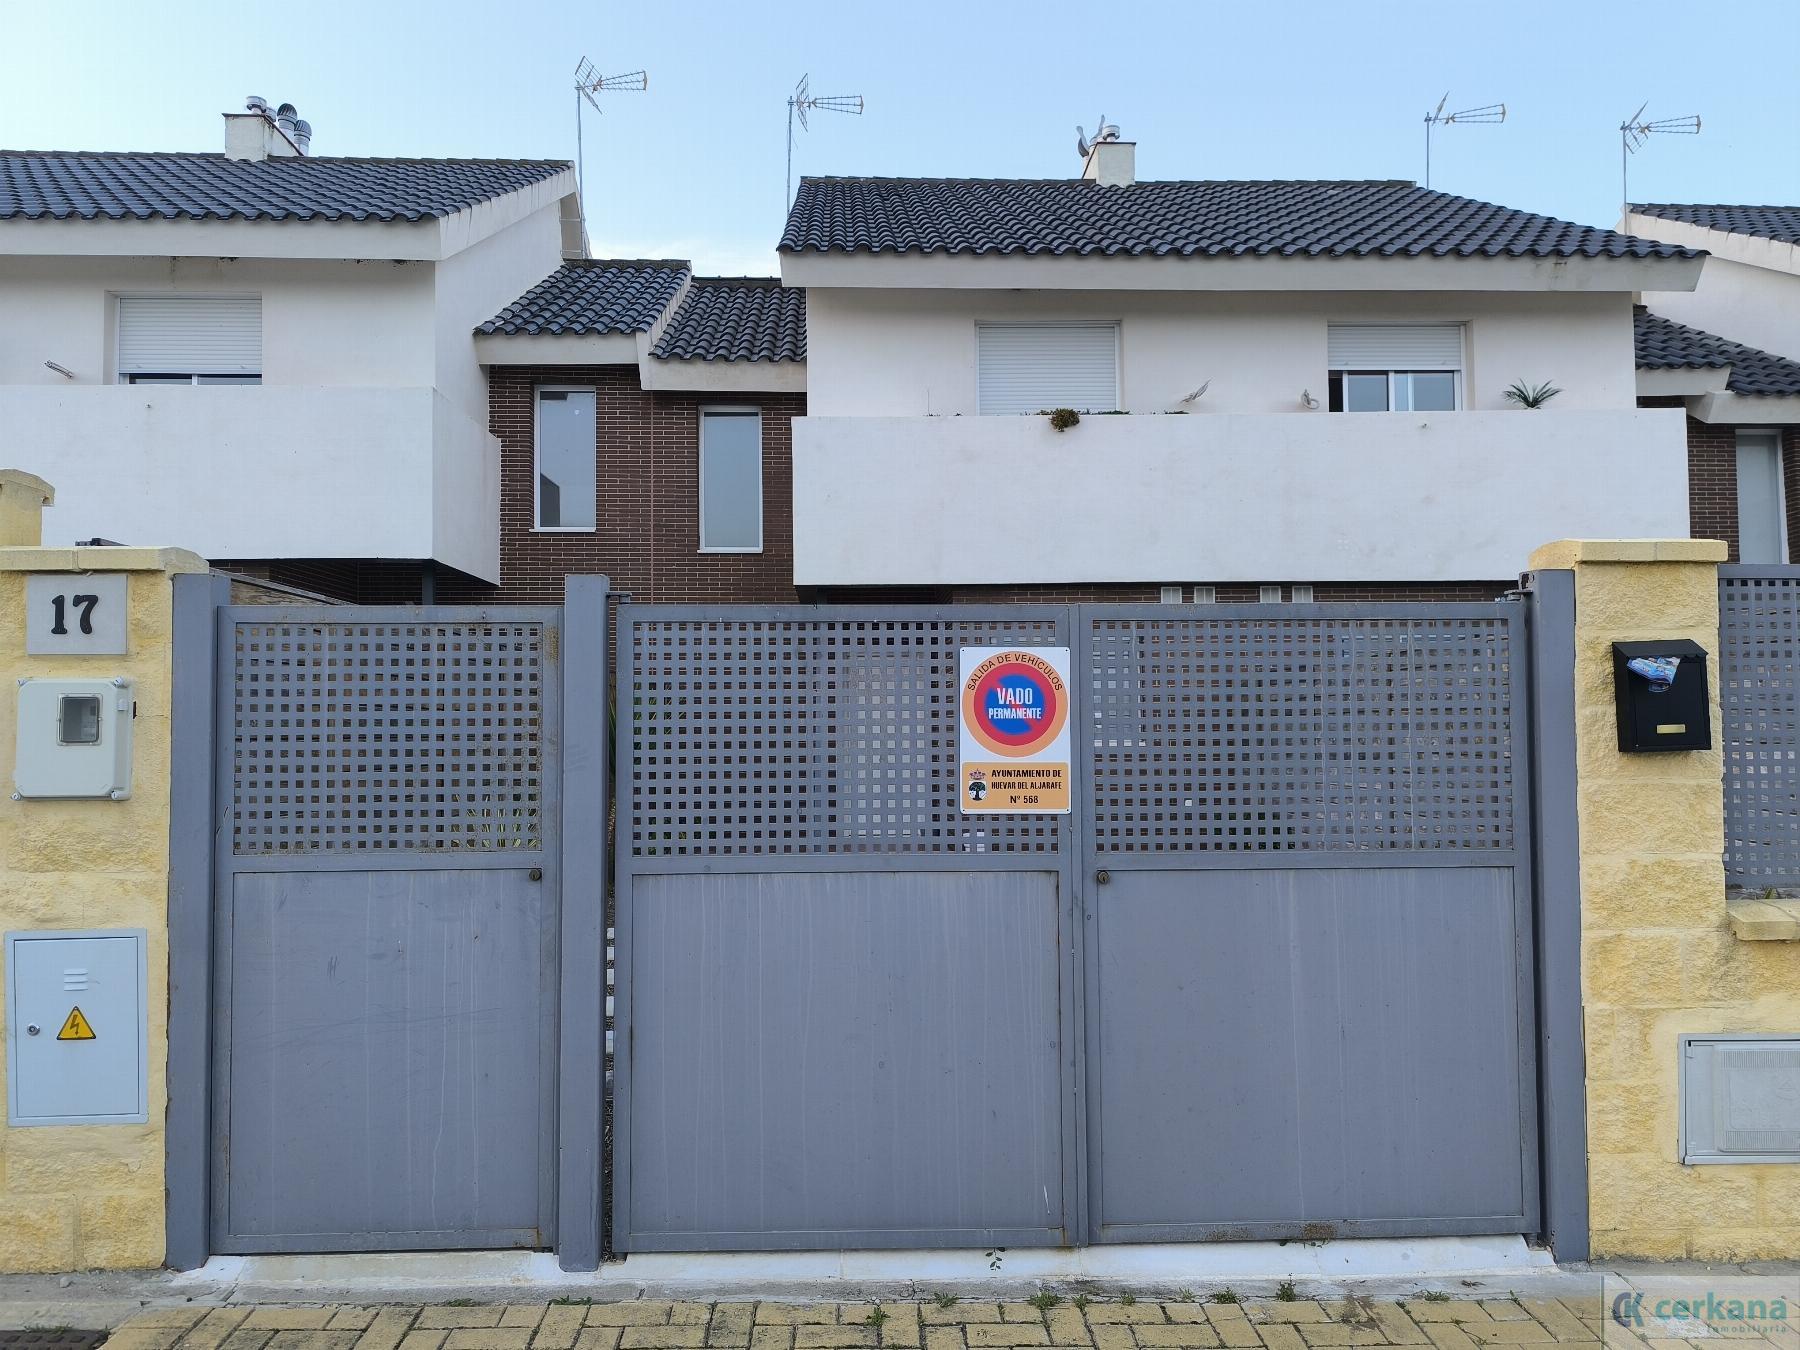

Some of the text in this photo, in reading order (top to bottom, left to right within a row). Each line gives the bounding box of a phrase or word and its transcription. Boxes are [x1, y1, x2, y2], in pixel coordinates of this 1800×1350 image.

[51, 594, 99, 635] 17
[967, 653, 1063, 691] SALIDA DE VEHÍCULOS
[997, 687, 1033, 705] VADO
[988, 707, 1042, 719] PERMANENTE
[991, 769, 1062, 778] AYUNTAMIENTO DE
[1017, 781, 1029, 790] DEL
[1029, 781, 1062, 790] ALJARAFE
[1023, 795, 1039, 804] 568
